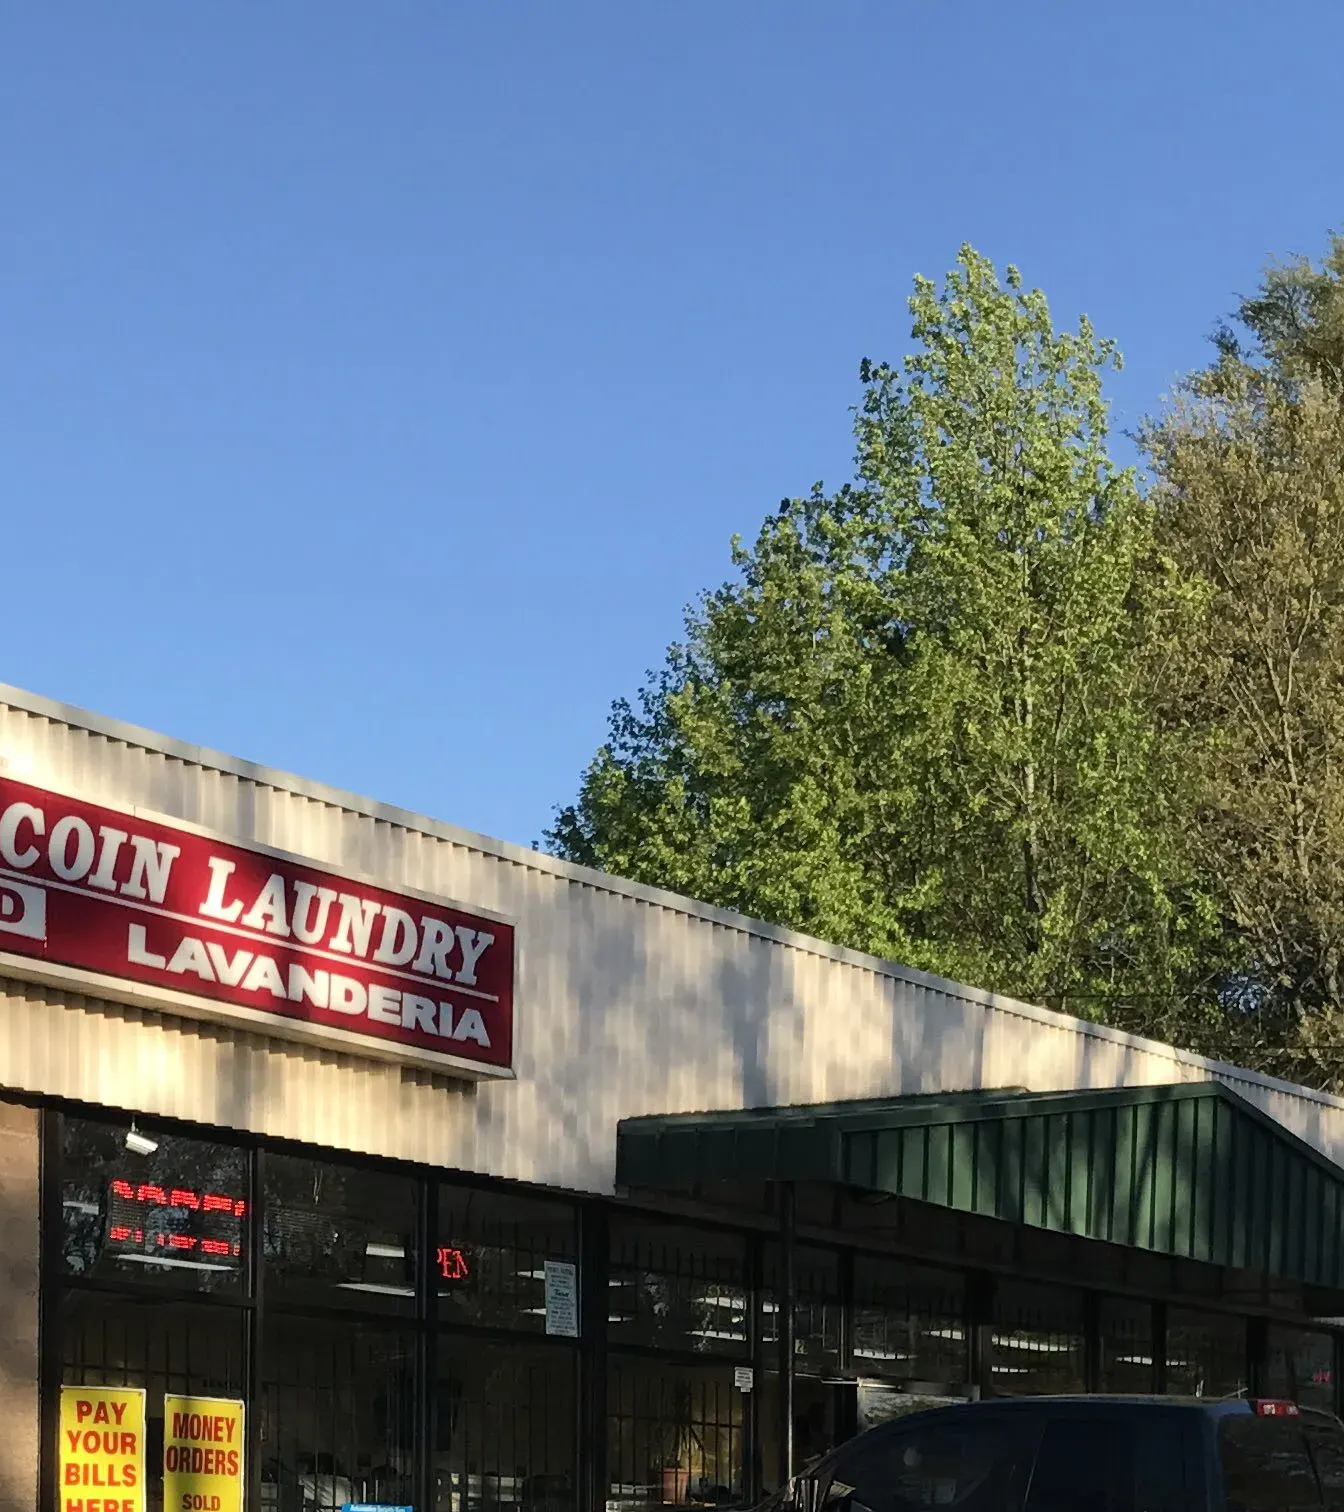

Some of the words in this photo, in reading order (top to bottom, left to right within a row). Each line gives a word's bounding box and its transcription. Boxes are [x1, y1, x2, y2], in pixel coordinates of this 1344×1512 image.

[198, 856, 494, 986] LAUNDRY
[127, 922, 491, 1048] LAVANDERIA
[76, 1400, 128, 1425] PAY
[172, 1412, 236, 1443] MONEY
[67, 1430, 137, 1455] YOUR
[64, 1463, 137, 1487] BILLS
[166, 1446, 239, 1477] ORDERS
[182, 1494, 220, 1511] SOLD
